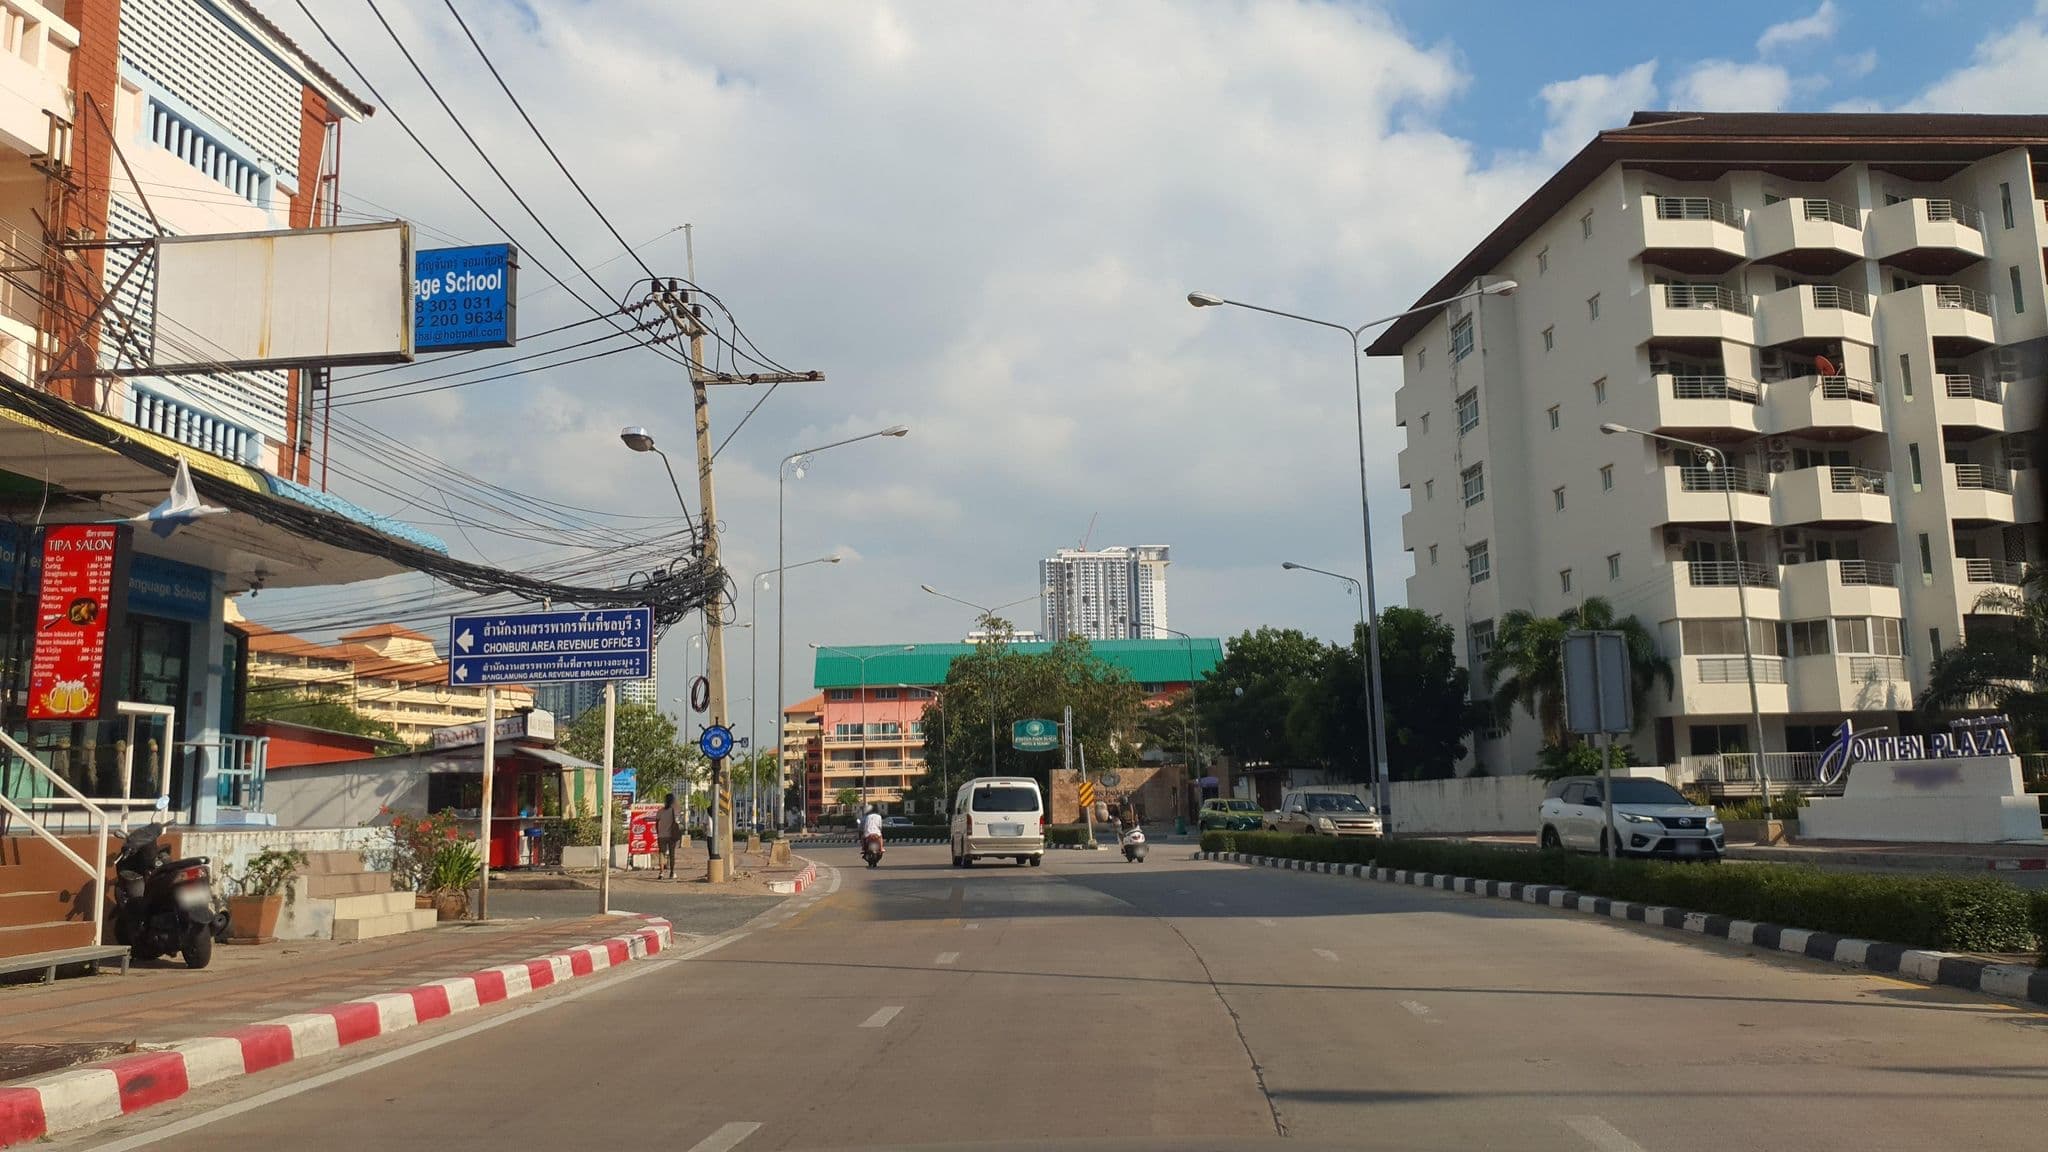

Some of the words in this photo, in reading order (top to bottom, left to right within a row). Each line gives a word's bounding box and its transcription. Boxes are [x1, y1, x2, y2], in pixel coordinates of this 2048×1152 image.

[445, 268, 502, 294] School
[430, 299, 457, 312] 303
[463, 296, 491, 310] 031
[430, 313, 459, 327] 200
[464, 310, 504, 325] 9634
[48, 540, 72, 551] TIPA
[76, 539, 112, 551] SALON
[129, 578, 171, 597] anguage
[175, 584, 207, 601] School
[634, 618, 641, 631] 3
[484, 641, 530, 654] CHONBURI
[531, 640, 555, 652] AREA
[557, 638, 599, 650] REVENUE
[601, 637, 634, 649] OFFICE
[635, 636, 641, 648] 3
[481, 673, 528, 681] BANGLAMUNG
[580, 669, 608, 677] BRANCH
[610, 668, 632, 676] OFFICE
[1816, 718, 1925, 786] JOMTIEN
[1931, 728, 2014, 758] PLAZA
